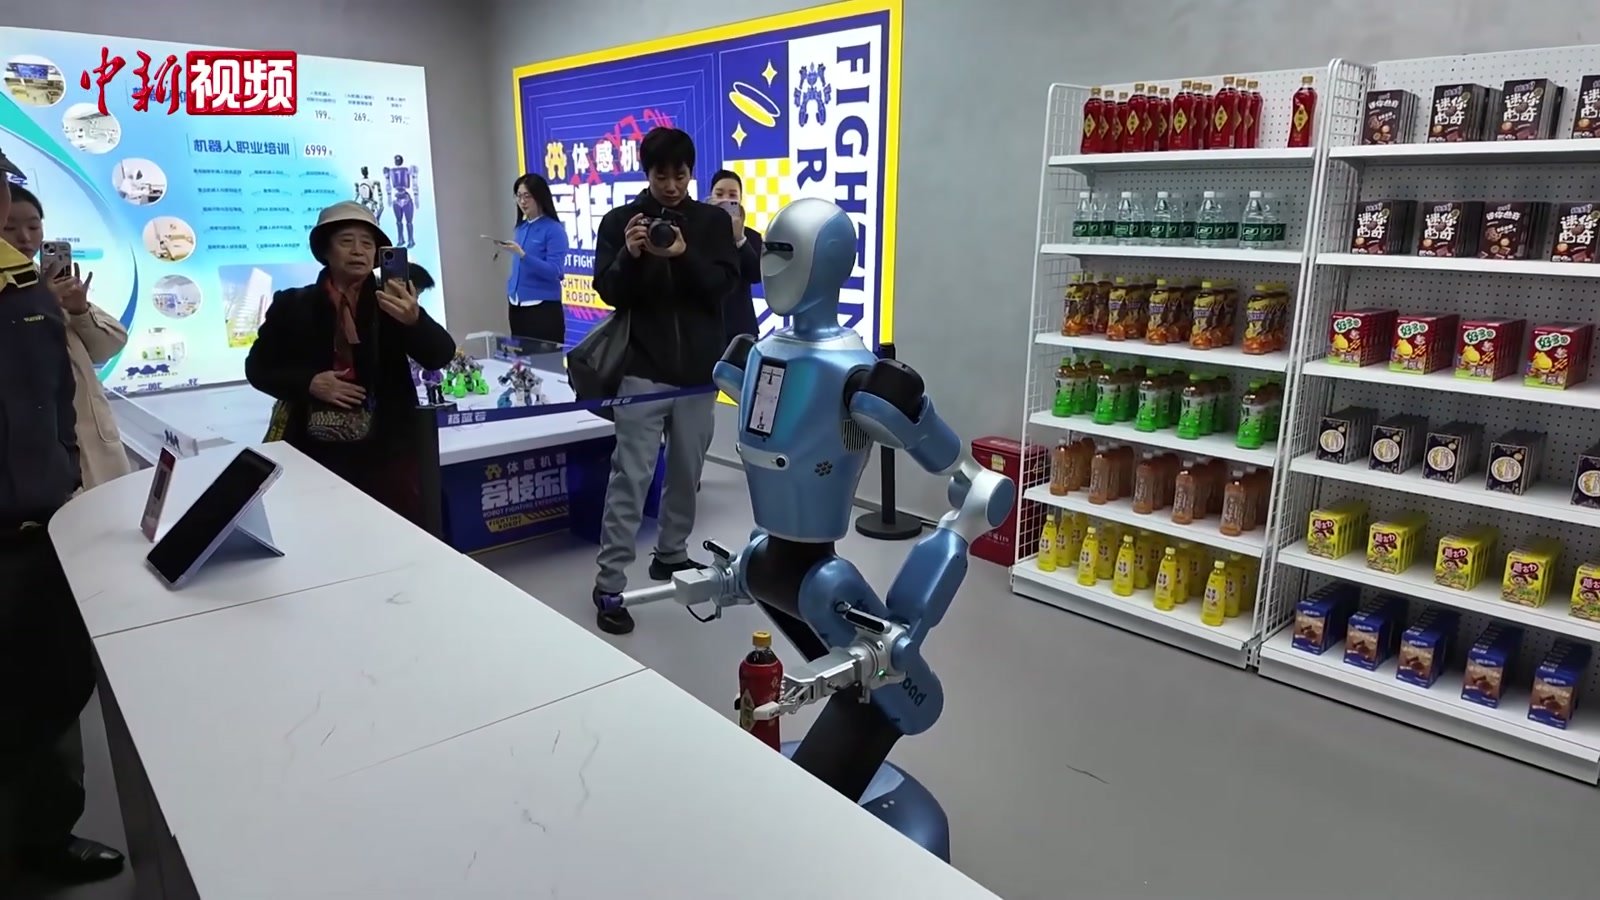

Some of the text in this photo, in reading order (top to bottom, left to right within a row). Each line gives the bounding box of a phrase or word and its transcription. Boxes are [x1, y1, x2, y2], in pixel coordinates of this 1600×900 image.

[193, 139, 290, 156] 机器人职业培训
[305, 144, 327, 156] 6999
[566, 291, 597, 304] ROBOT
